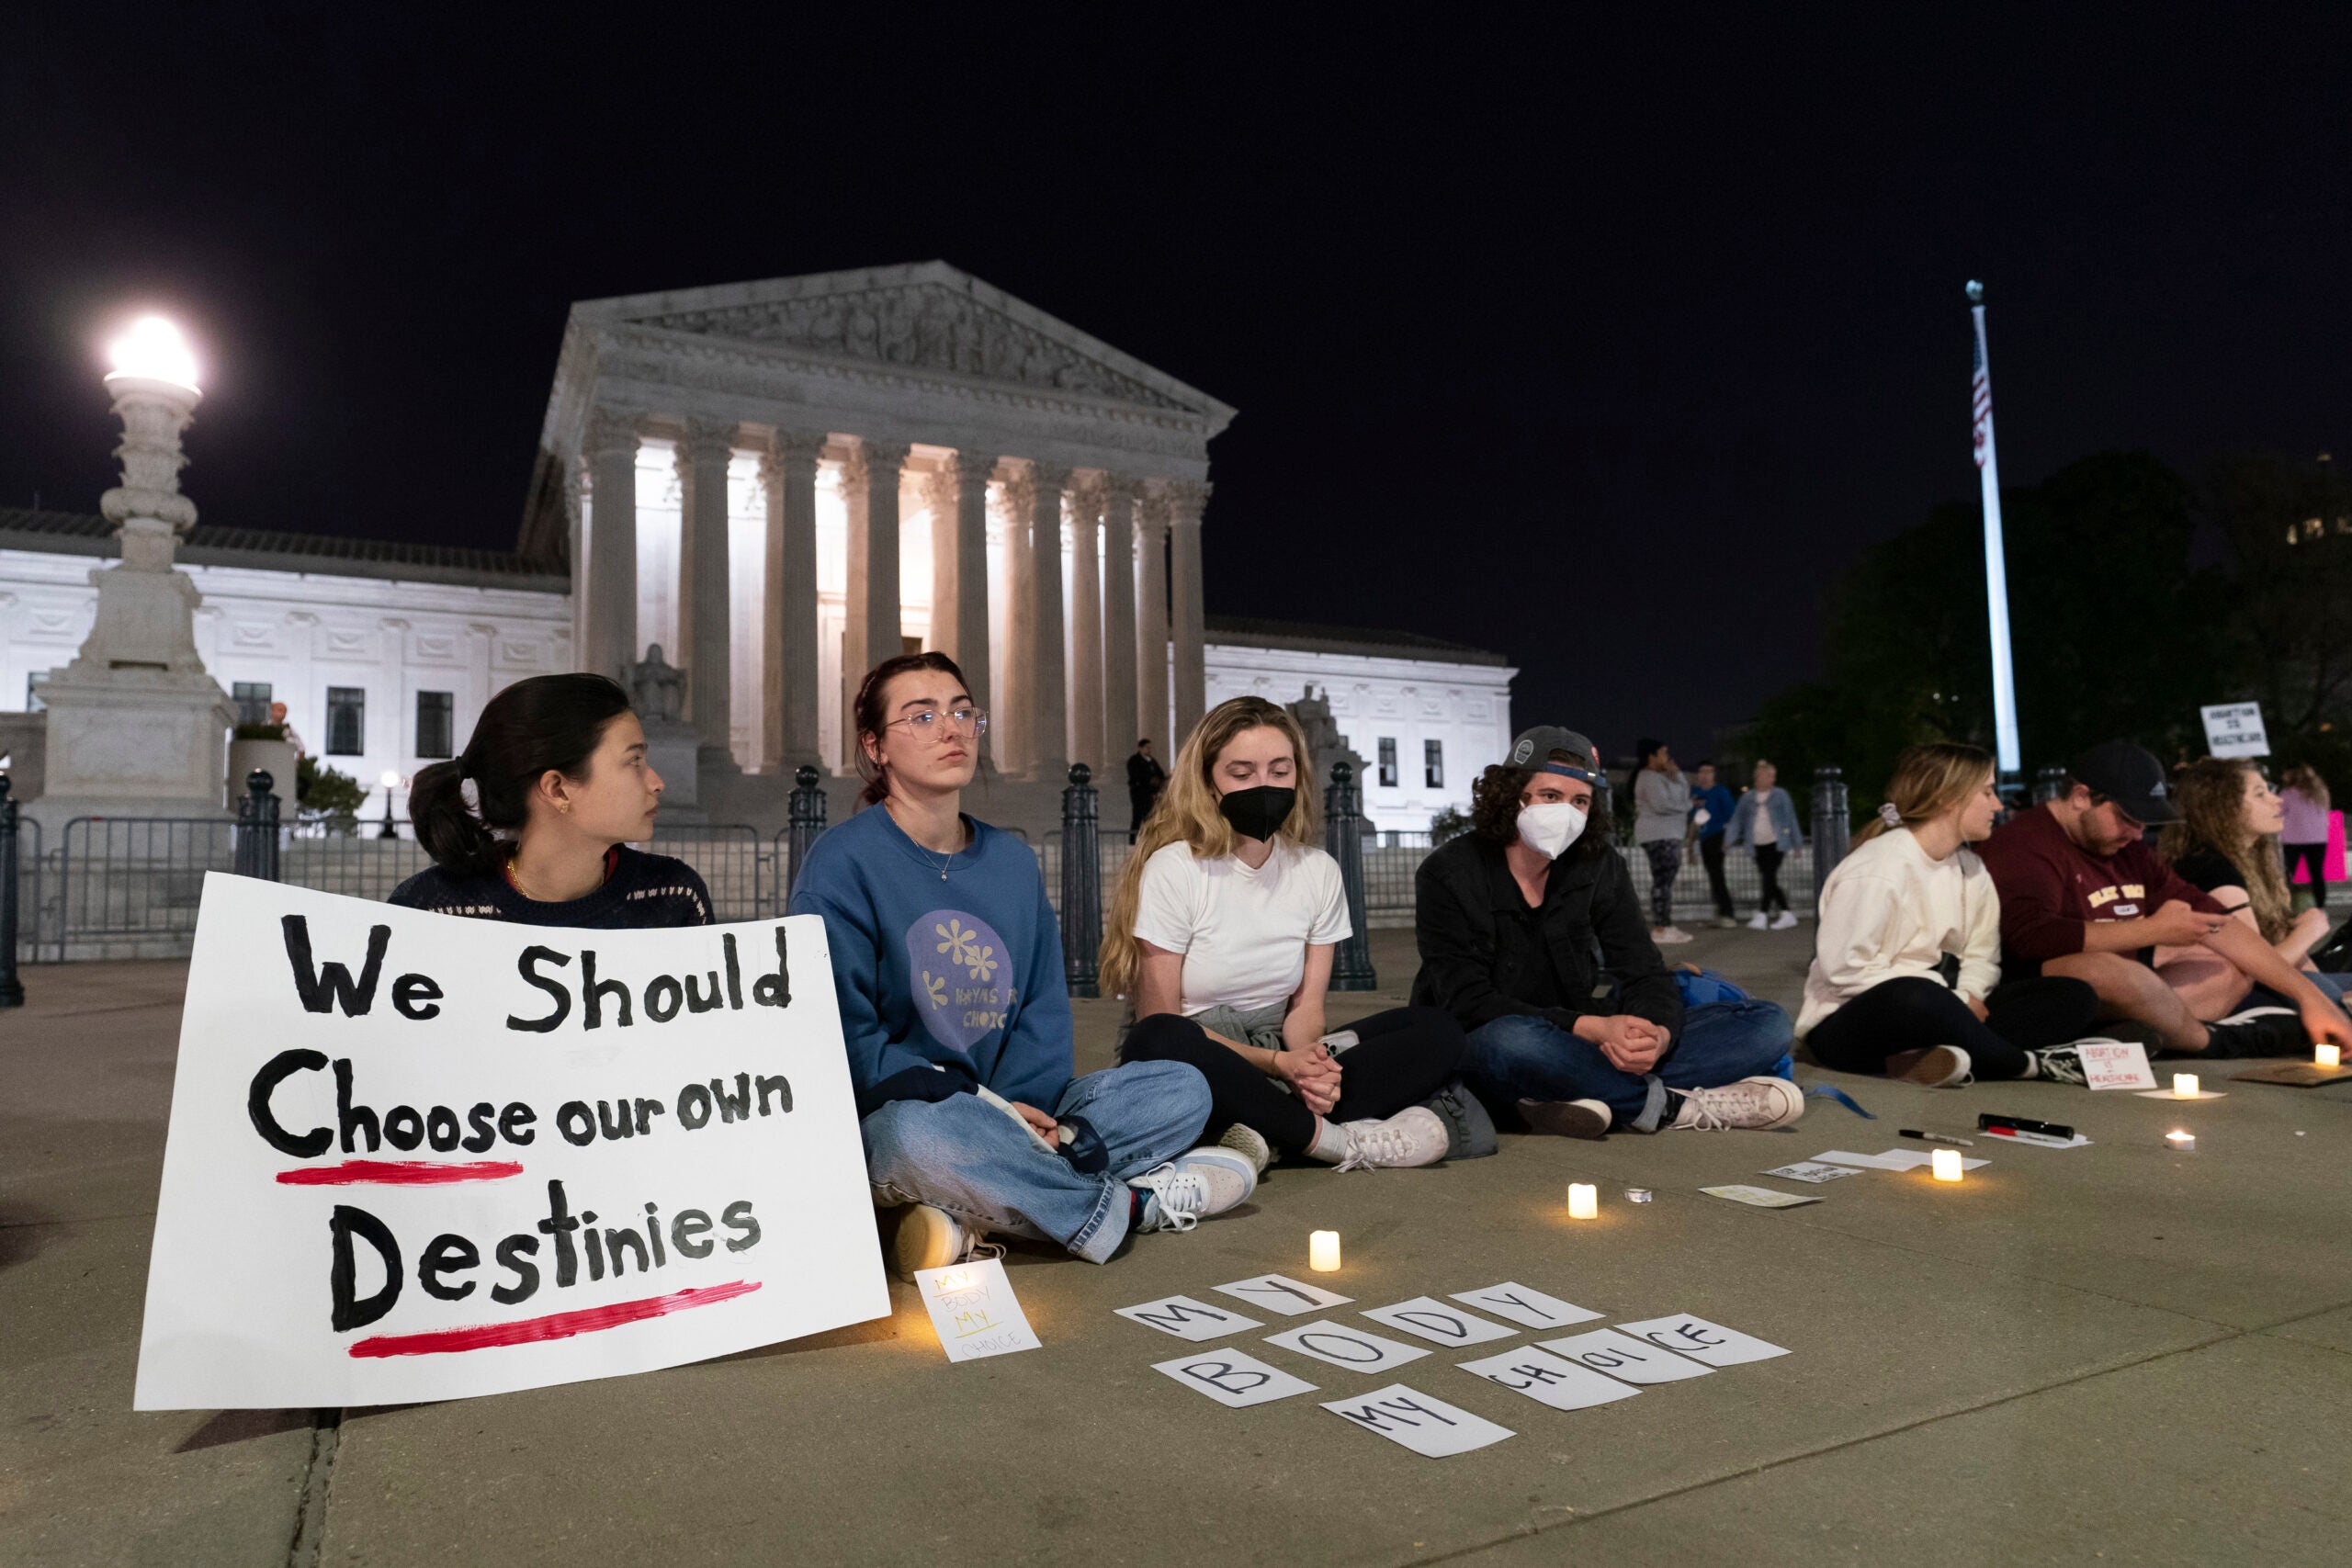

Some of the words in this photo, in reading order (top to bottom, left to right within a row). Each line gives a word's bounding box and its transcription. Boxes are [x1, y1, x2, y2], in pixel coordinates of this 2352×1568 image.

[281, 915, 443, 1018] We
[507, 927, 791, 1032] Should
[248, 1049, 537, 1158] Choose
[557, 1093, 664, 1146] our
[677, 1072, 793, 1131] own
[329, 1179, 761, 1333] Destinies
[934, 1271, 969, 1291] MY
[941, 1286, 991, 1313] BODY
[955, 1309, 989, 1332] MY
[961, 1331, 1022, 1359] CHOICE
[1344, 1397, 1457, 1431] MY
